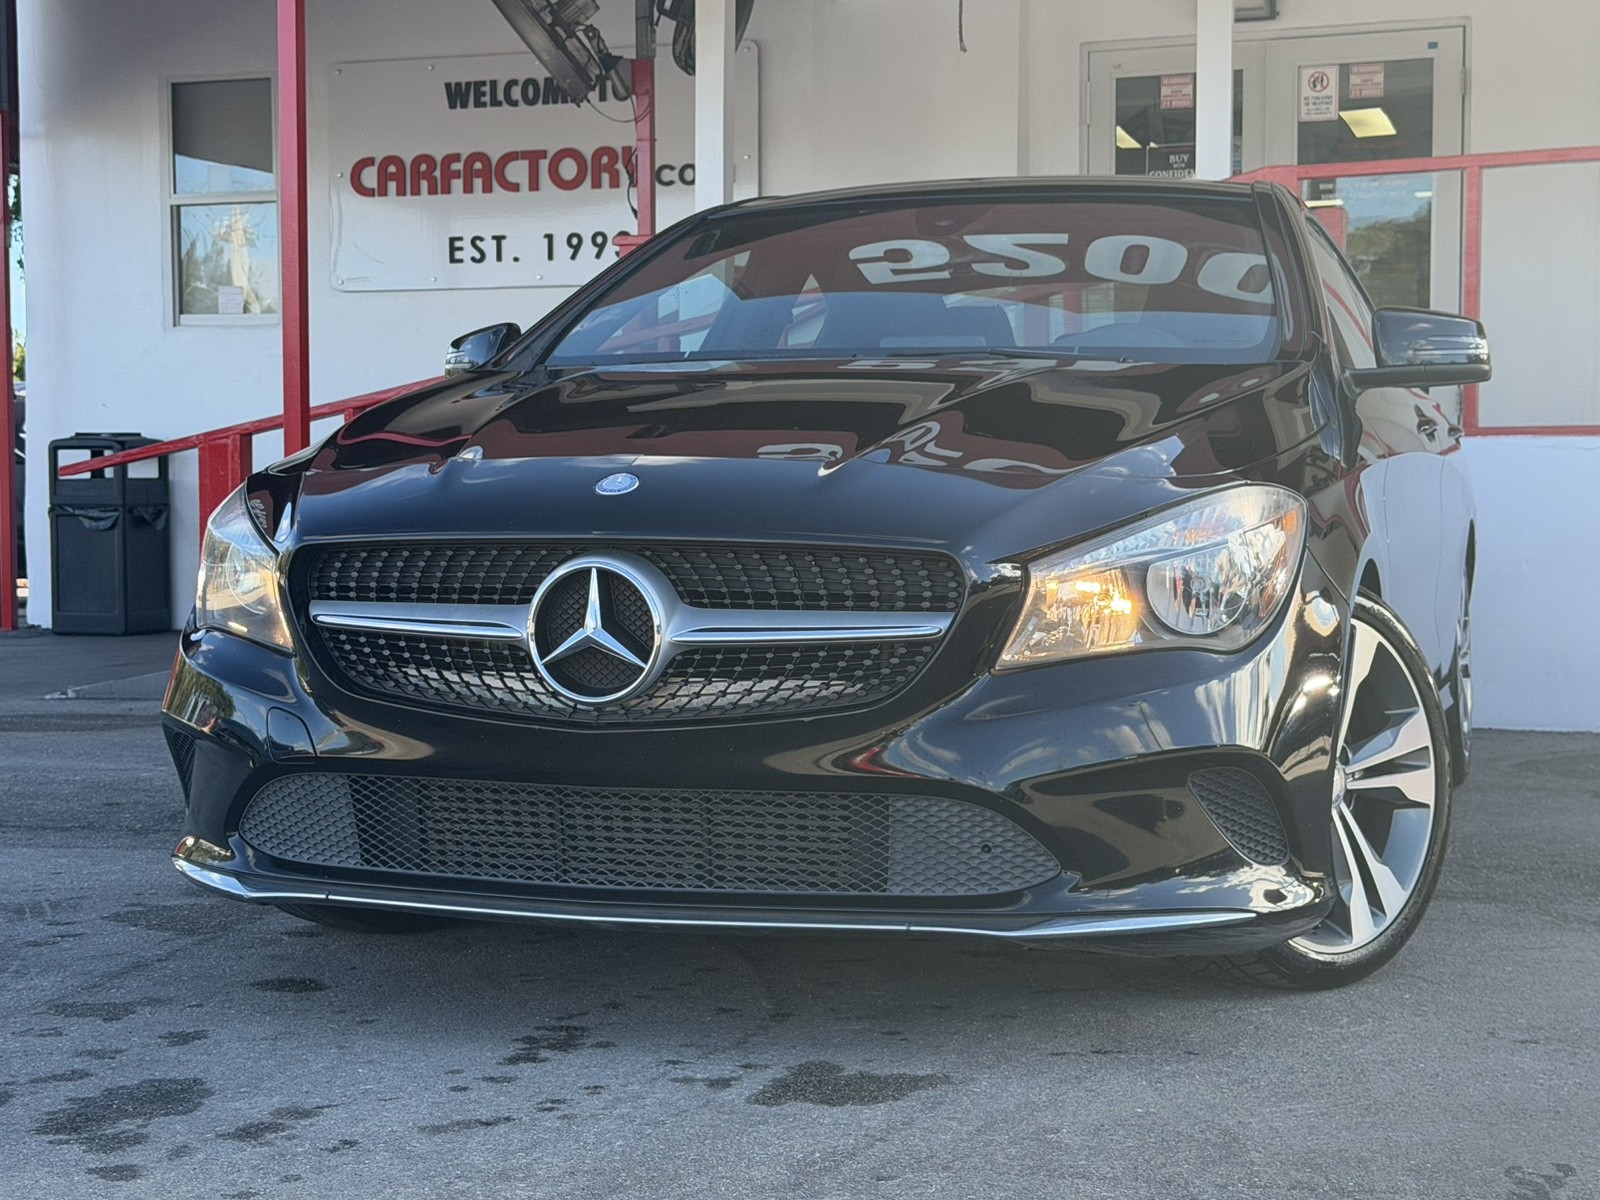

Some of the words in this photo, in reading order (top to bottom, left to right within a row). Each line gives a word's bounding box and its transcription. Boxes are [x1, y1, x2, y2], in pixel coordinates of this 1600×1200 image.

[444, 77, 584, 110] WELCOM
[1168, 153, 1190, 164] BUY
[448, 234, 521, 264] EST.
